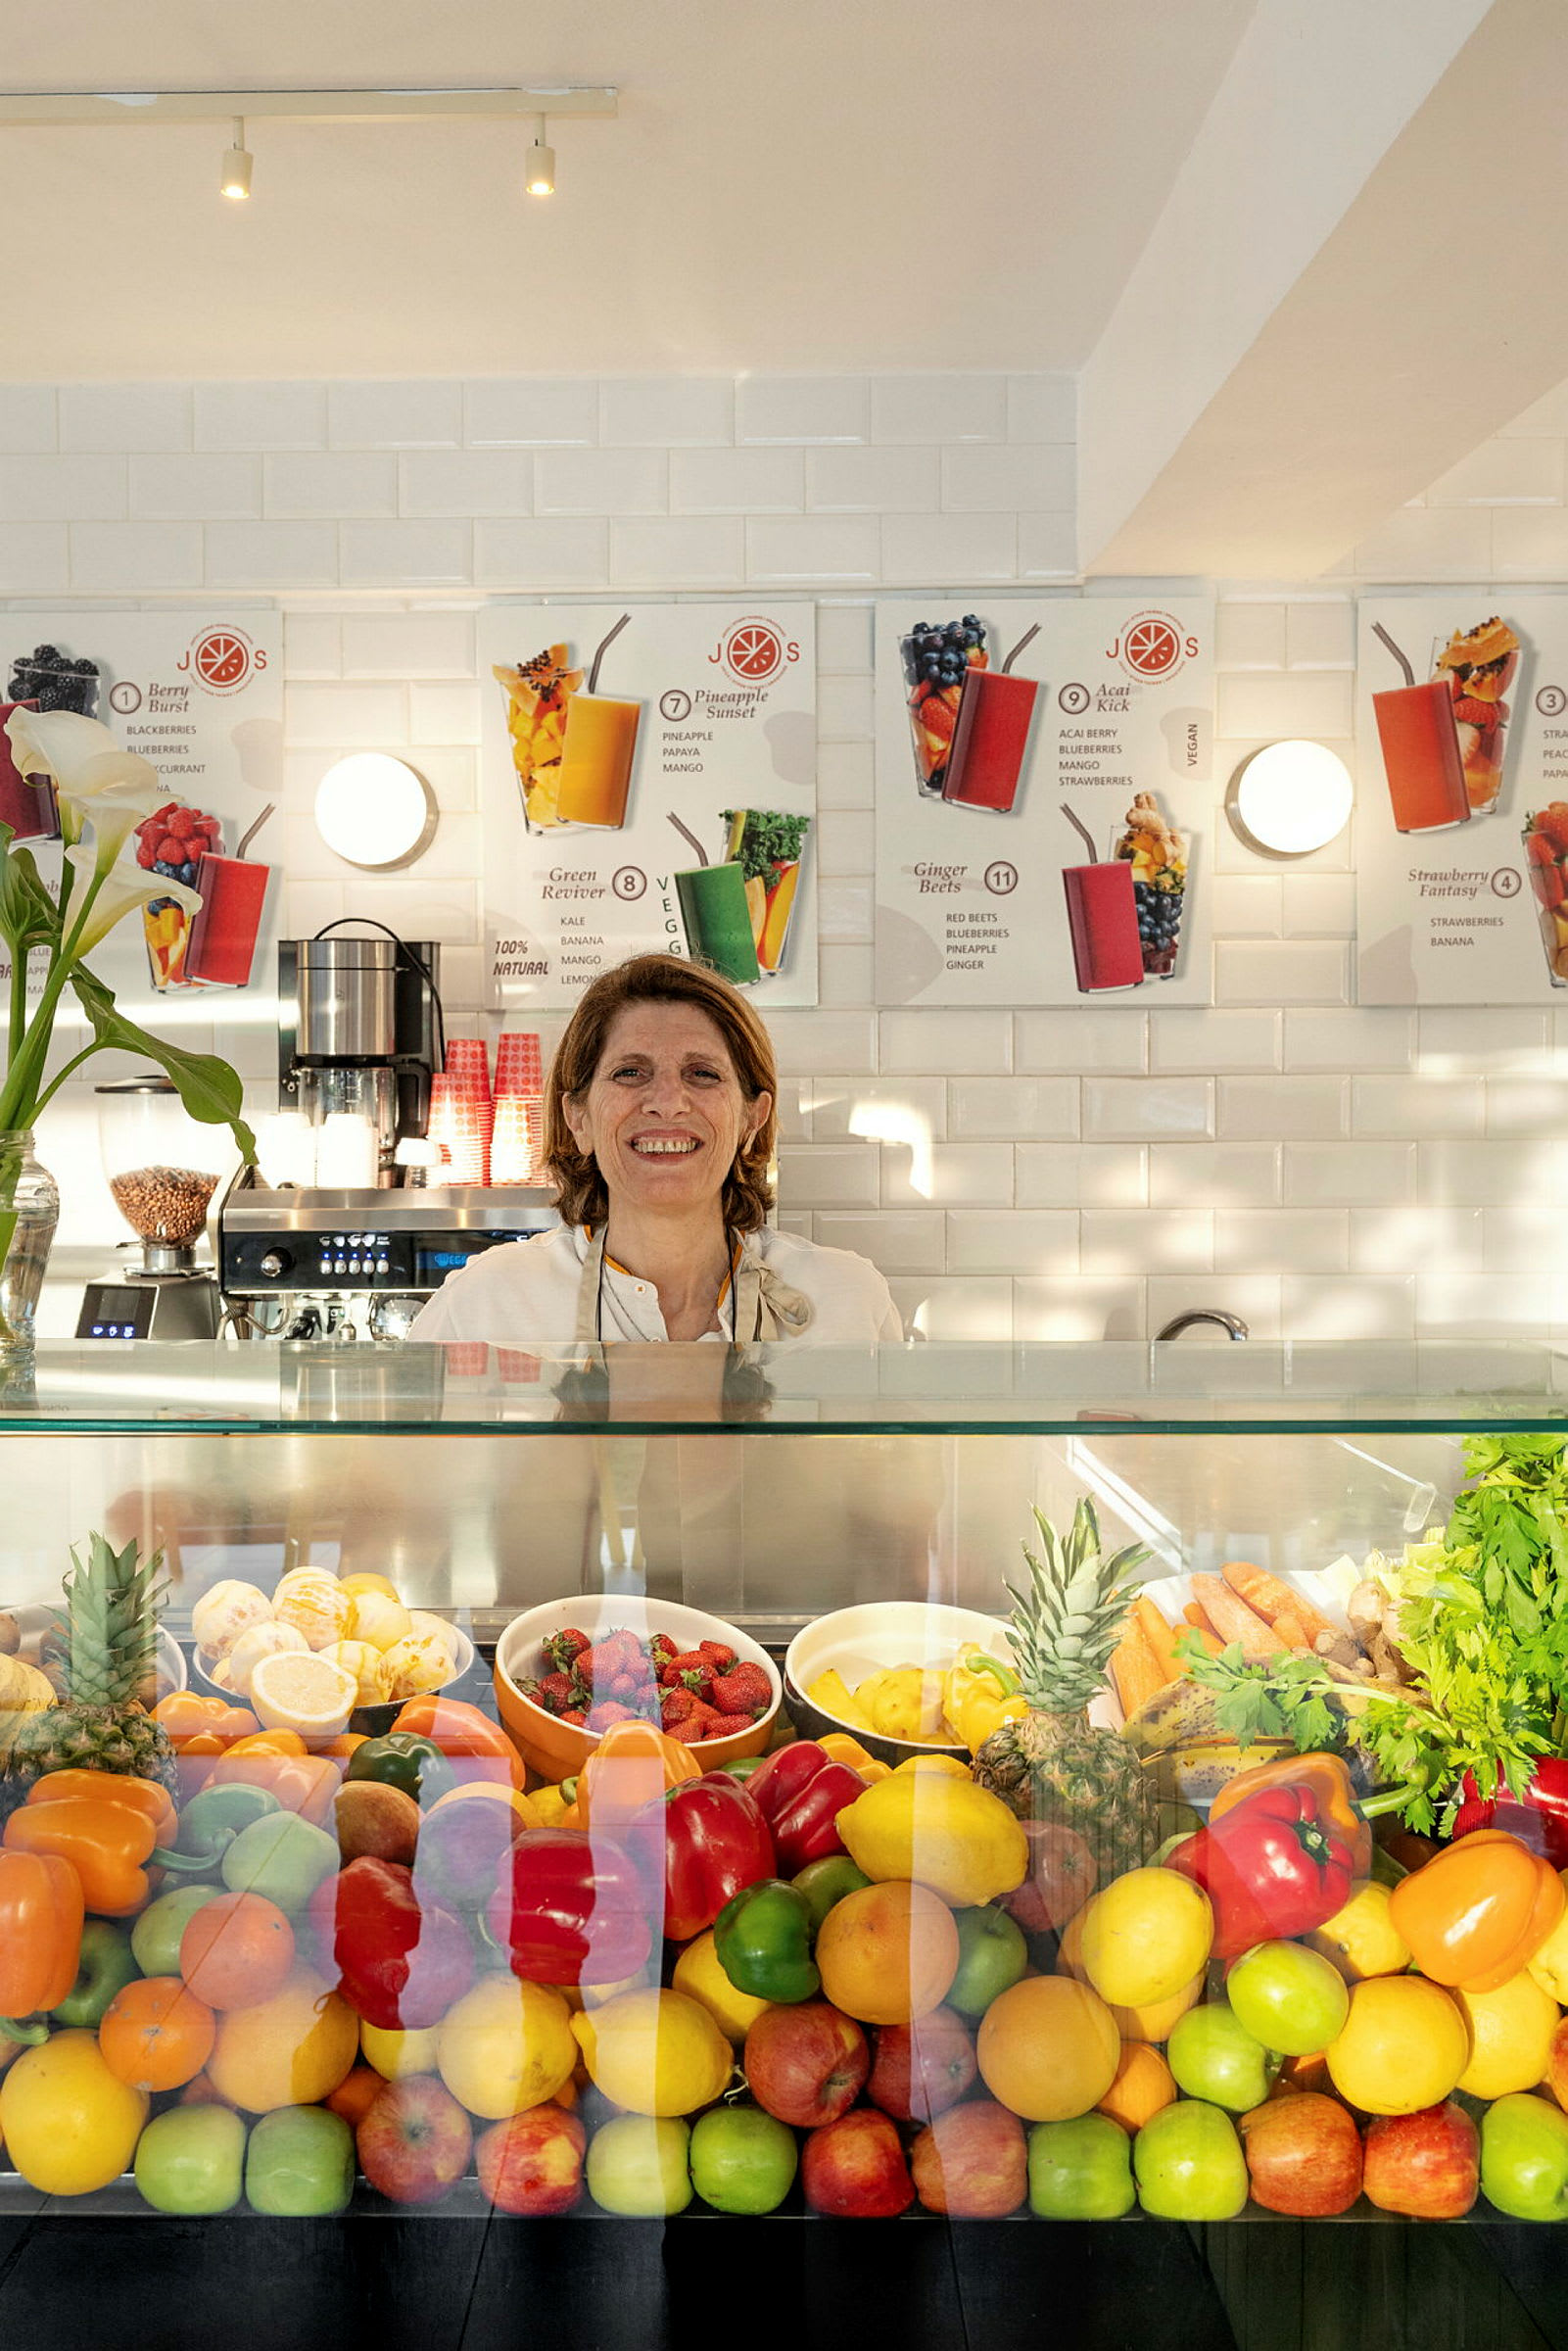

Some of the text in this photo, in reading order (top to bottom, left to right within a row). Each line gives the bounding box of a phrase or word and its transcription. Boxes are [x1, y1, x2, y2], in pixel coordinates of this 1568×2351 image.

[708, 642, 799, 663] J S
[1106, 637, 1198, 658] J S
[177, 650, 266, 670] J S
[149, 684, 189, 701] Berry
[1096, 684, 1130, 696] Acai
[121, 691, 127, 705] 1
[695, 688, 768, 706] Pineapple
[1069, 692, 1079, 705] 9
[1546, 694, 1556, 708] 3
[149, 698, 188, 712] Burst
[670, 698, 681, 713] 7
[707, 704, 755, 718] Sunset
[1097, 698, 1129, 711] Kick
[127, 726, 196, 735] BLACKBERRIES
[663, 732, 713, 741] PINEAPPLE
[1059, 729, 1117, 738] ACAI BERRY
[127, 744, 189, 754] BLUEBERRIES
[1060, 744, 1122, 754] BLUEBERRIES
[1187, 724, 1198, 766] VEGAN
[663, 763, 703, 772] MANGO
[1059, 761, 1100, 770] MANGO
[1059, 777, 1132, 786] STRAWBERRIES
[549, 868, 596, 882] Green
[914, 862, 968, 882] Ginger
[1408, 869, 1489, 886] Strawberry
[624, 876, 635, 891] 8
[920, 879, 961, 892] Beets
[993, 871, 1013, 887] 11
[1501, 876, 1511, 889] 4
[543, 885, 605, 899] Reviver
[1420, 885, 1477, 900] Fantasy
[561, 917, 585, 926] KALE
[946, 913, 997, 923] RED BEETS
[1431, 917, 1503, 927] STRAWBERRIES
[946, 929, 1010, 938] BLUEBERRIES
[561, 936, 603, 945] BANANA
[1431, 937, 1474, 946] BANANA
[493, 940, 528, 955] 100%
[947, 944, 996, 953] PINEAPPLE
[561, 955, 601, 964] MANGO
[946, 960, 983, 970] GINGER
[493, 962, 548, 976] NATURAL
